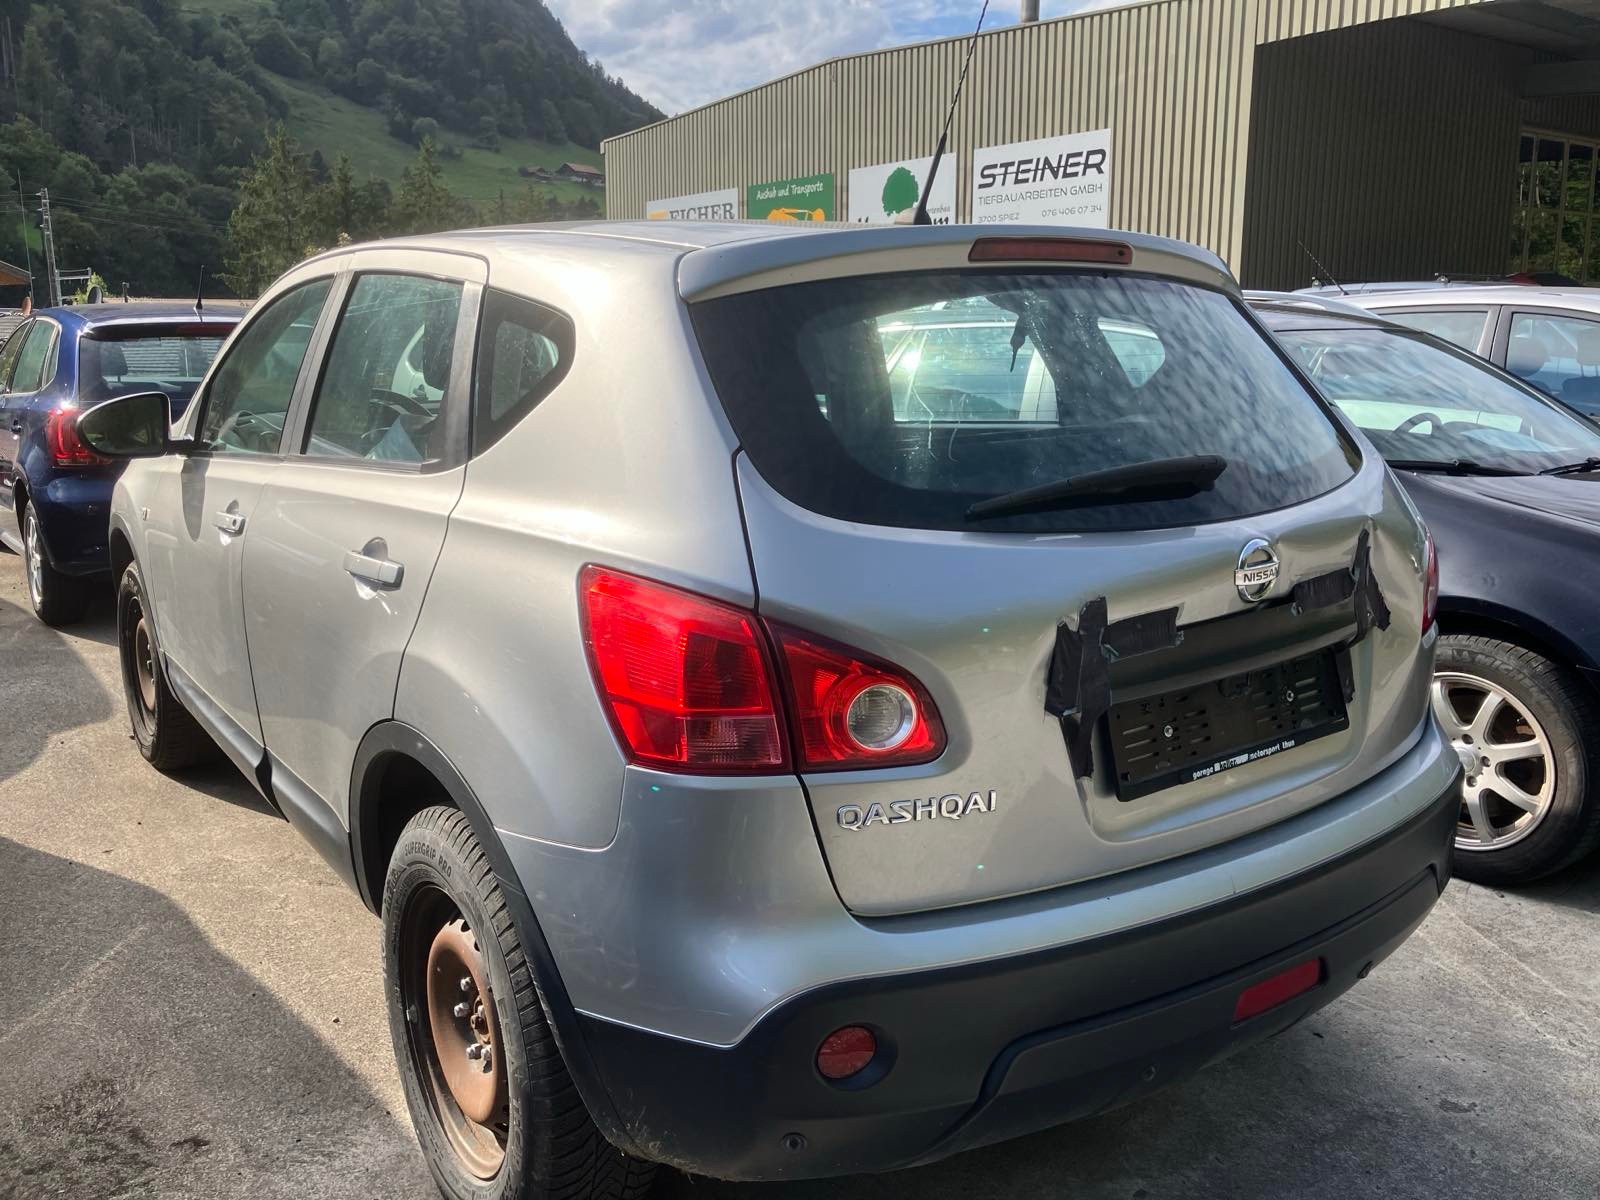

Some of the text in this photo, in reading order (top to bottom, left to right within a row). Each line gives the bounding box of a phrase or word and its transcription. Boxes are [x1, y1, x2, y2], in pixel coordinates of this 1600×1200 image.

[978, 149, 1106, 189] STEINER
[778, 184, 789, 196] und
[791, 181, 823, 197] Transporte
[978, 183, 1102, 206] TIEFBAUARBEITEN GMBH
[1041, 209, 1057, 217] 076
[1060, 207, 1075, 215] 406
[1077, 206, 1088, 214] 07
[1244, 564, 1279, 583] NISSAN
[837, 790, 997, 831] QASHQAI
[404, 841, 452, 877] SUPERGRIP PRO
